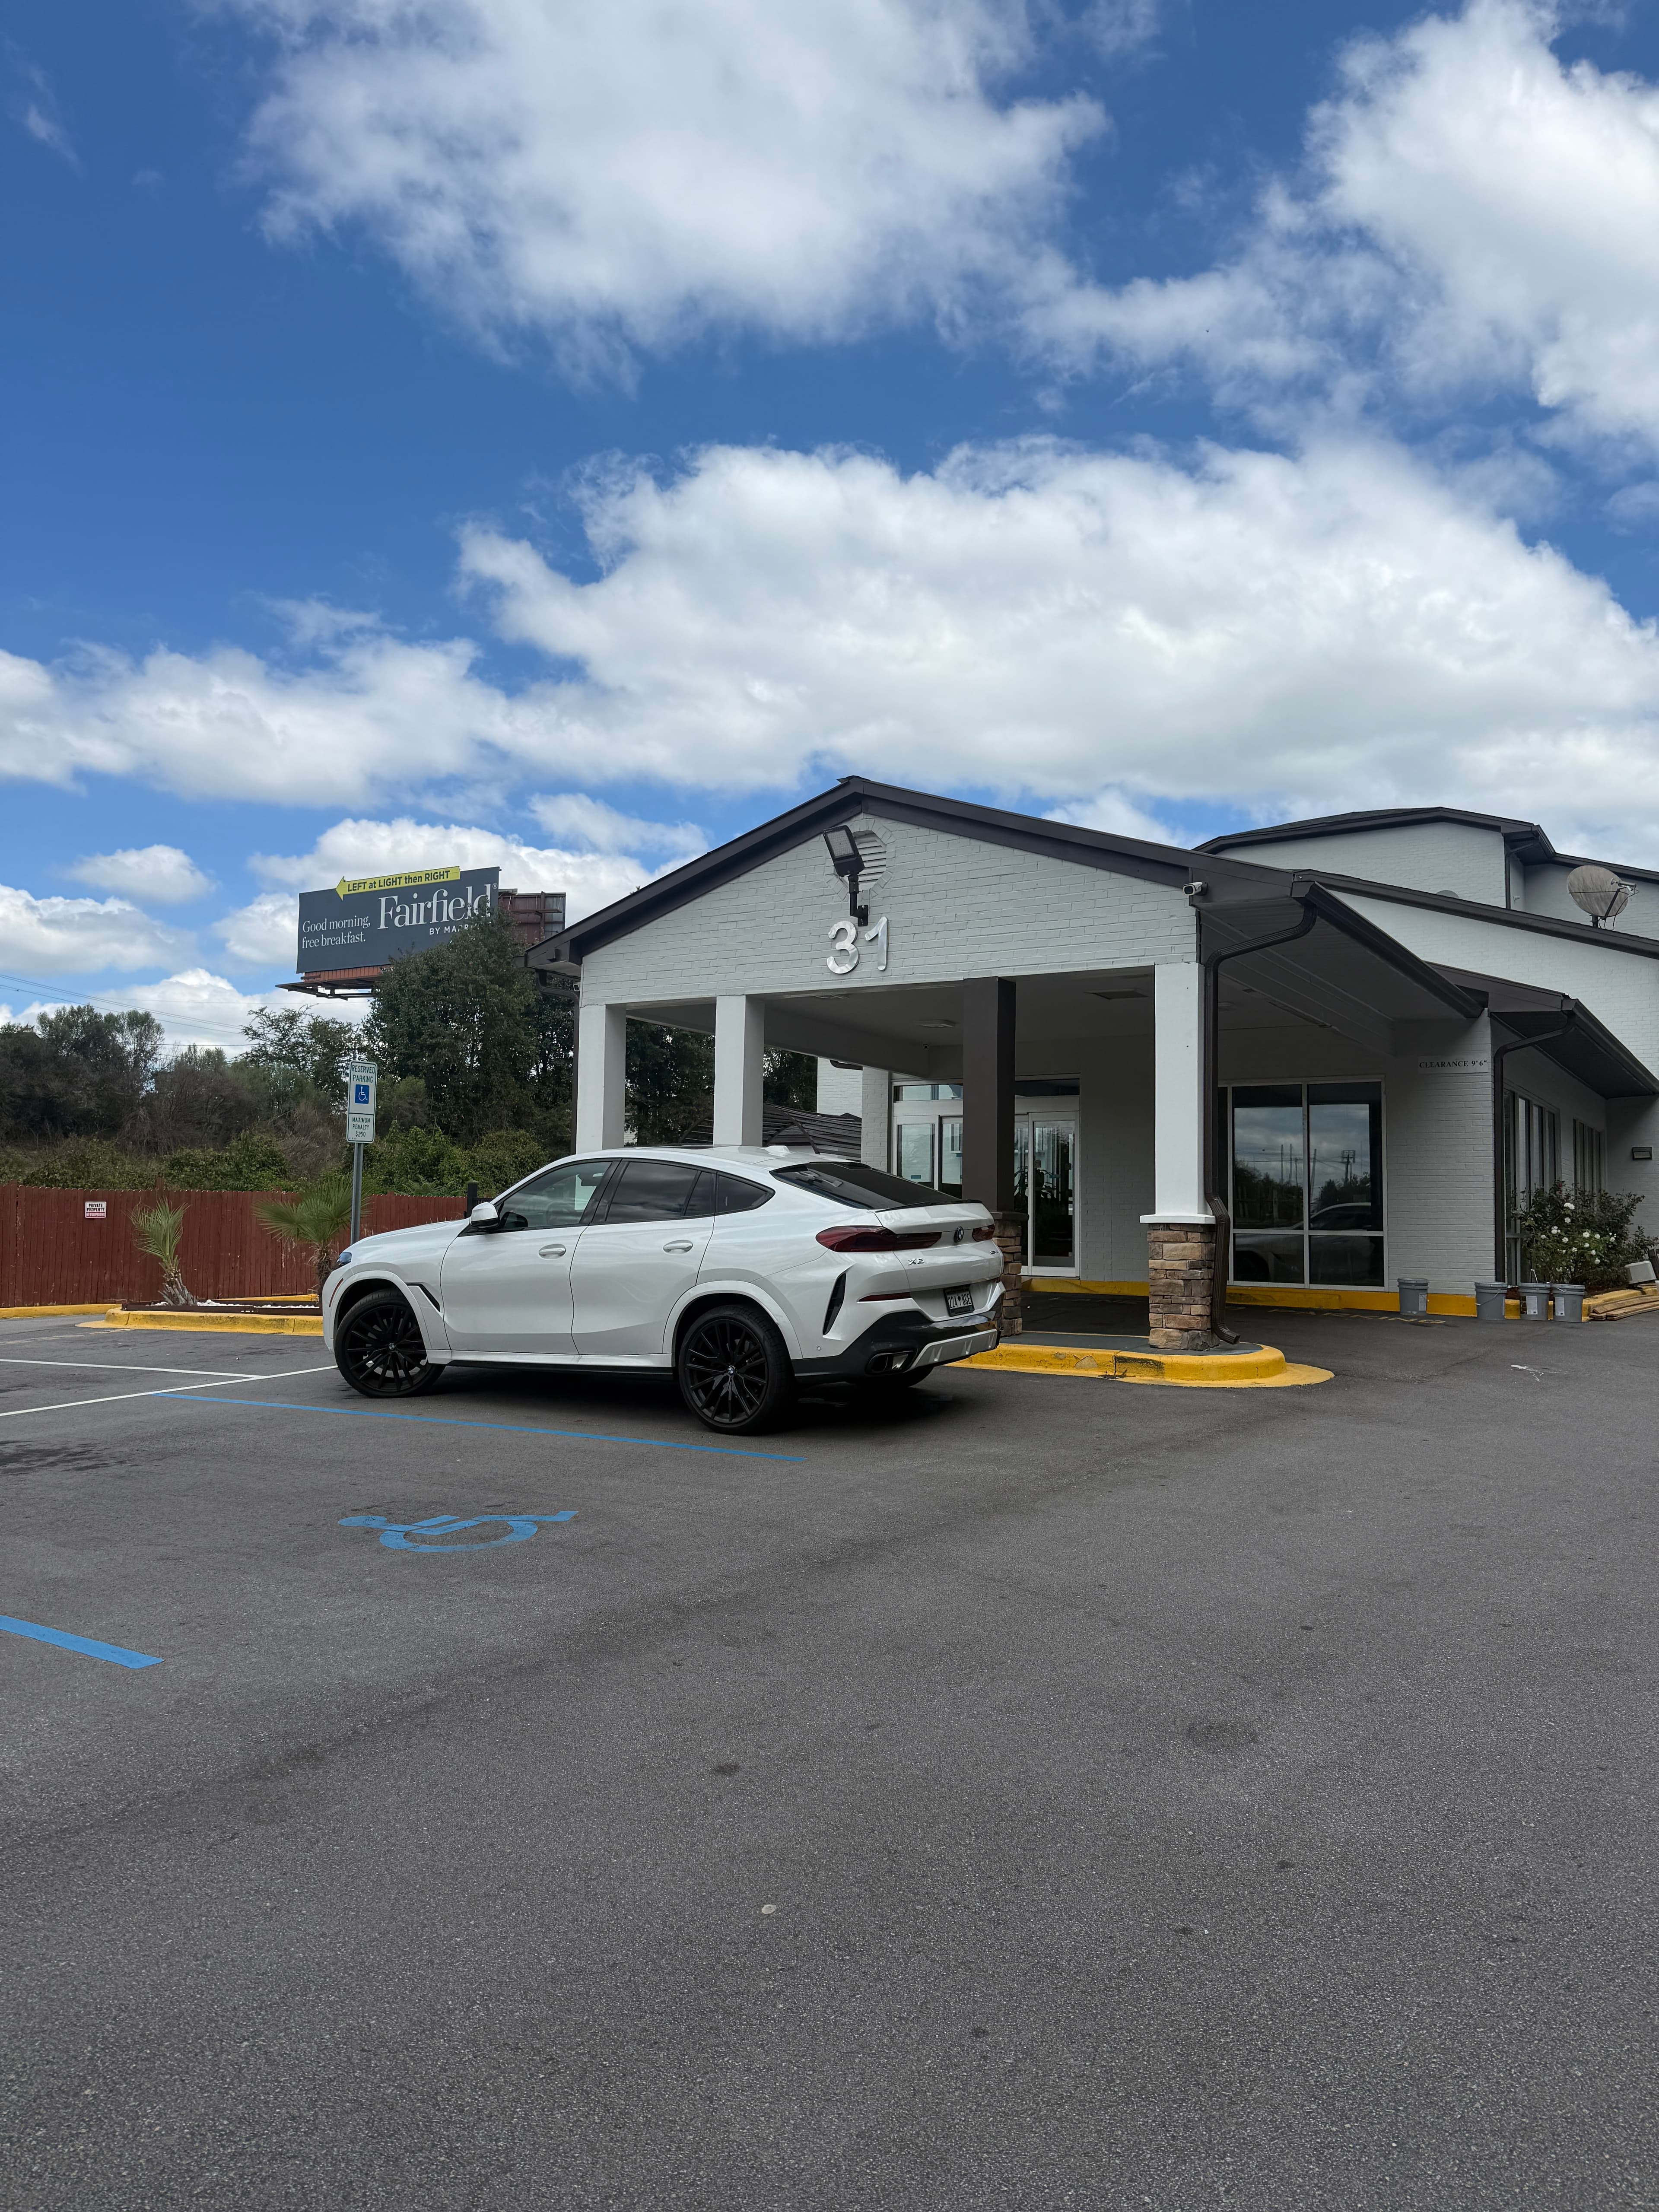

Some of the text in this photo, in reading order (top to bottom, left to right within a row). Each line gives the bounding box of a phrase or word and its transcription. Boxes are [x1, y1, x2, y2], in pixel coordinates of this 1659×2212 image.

[348, 881, 366, 892] LEFT
[378, 877, 402, 887] LIGHT
[404, 875, 422, 884] then
[425, 870, 450, 882] RIGHT
[377, 884, 491, 929] Fairfield
[302, 915, 370, 933] Good morning,
[302, 931, 366, 949] free breakfast.
[826, 916, 888, 974] 31
[352, 1065, 375, 1074] RESERVED
[353, 1074, 373, 1083] PARKING
[948, 1293, 972, 1308] 224 BGE
